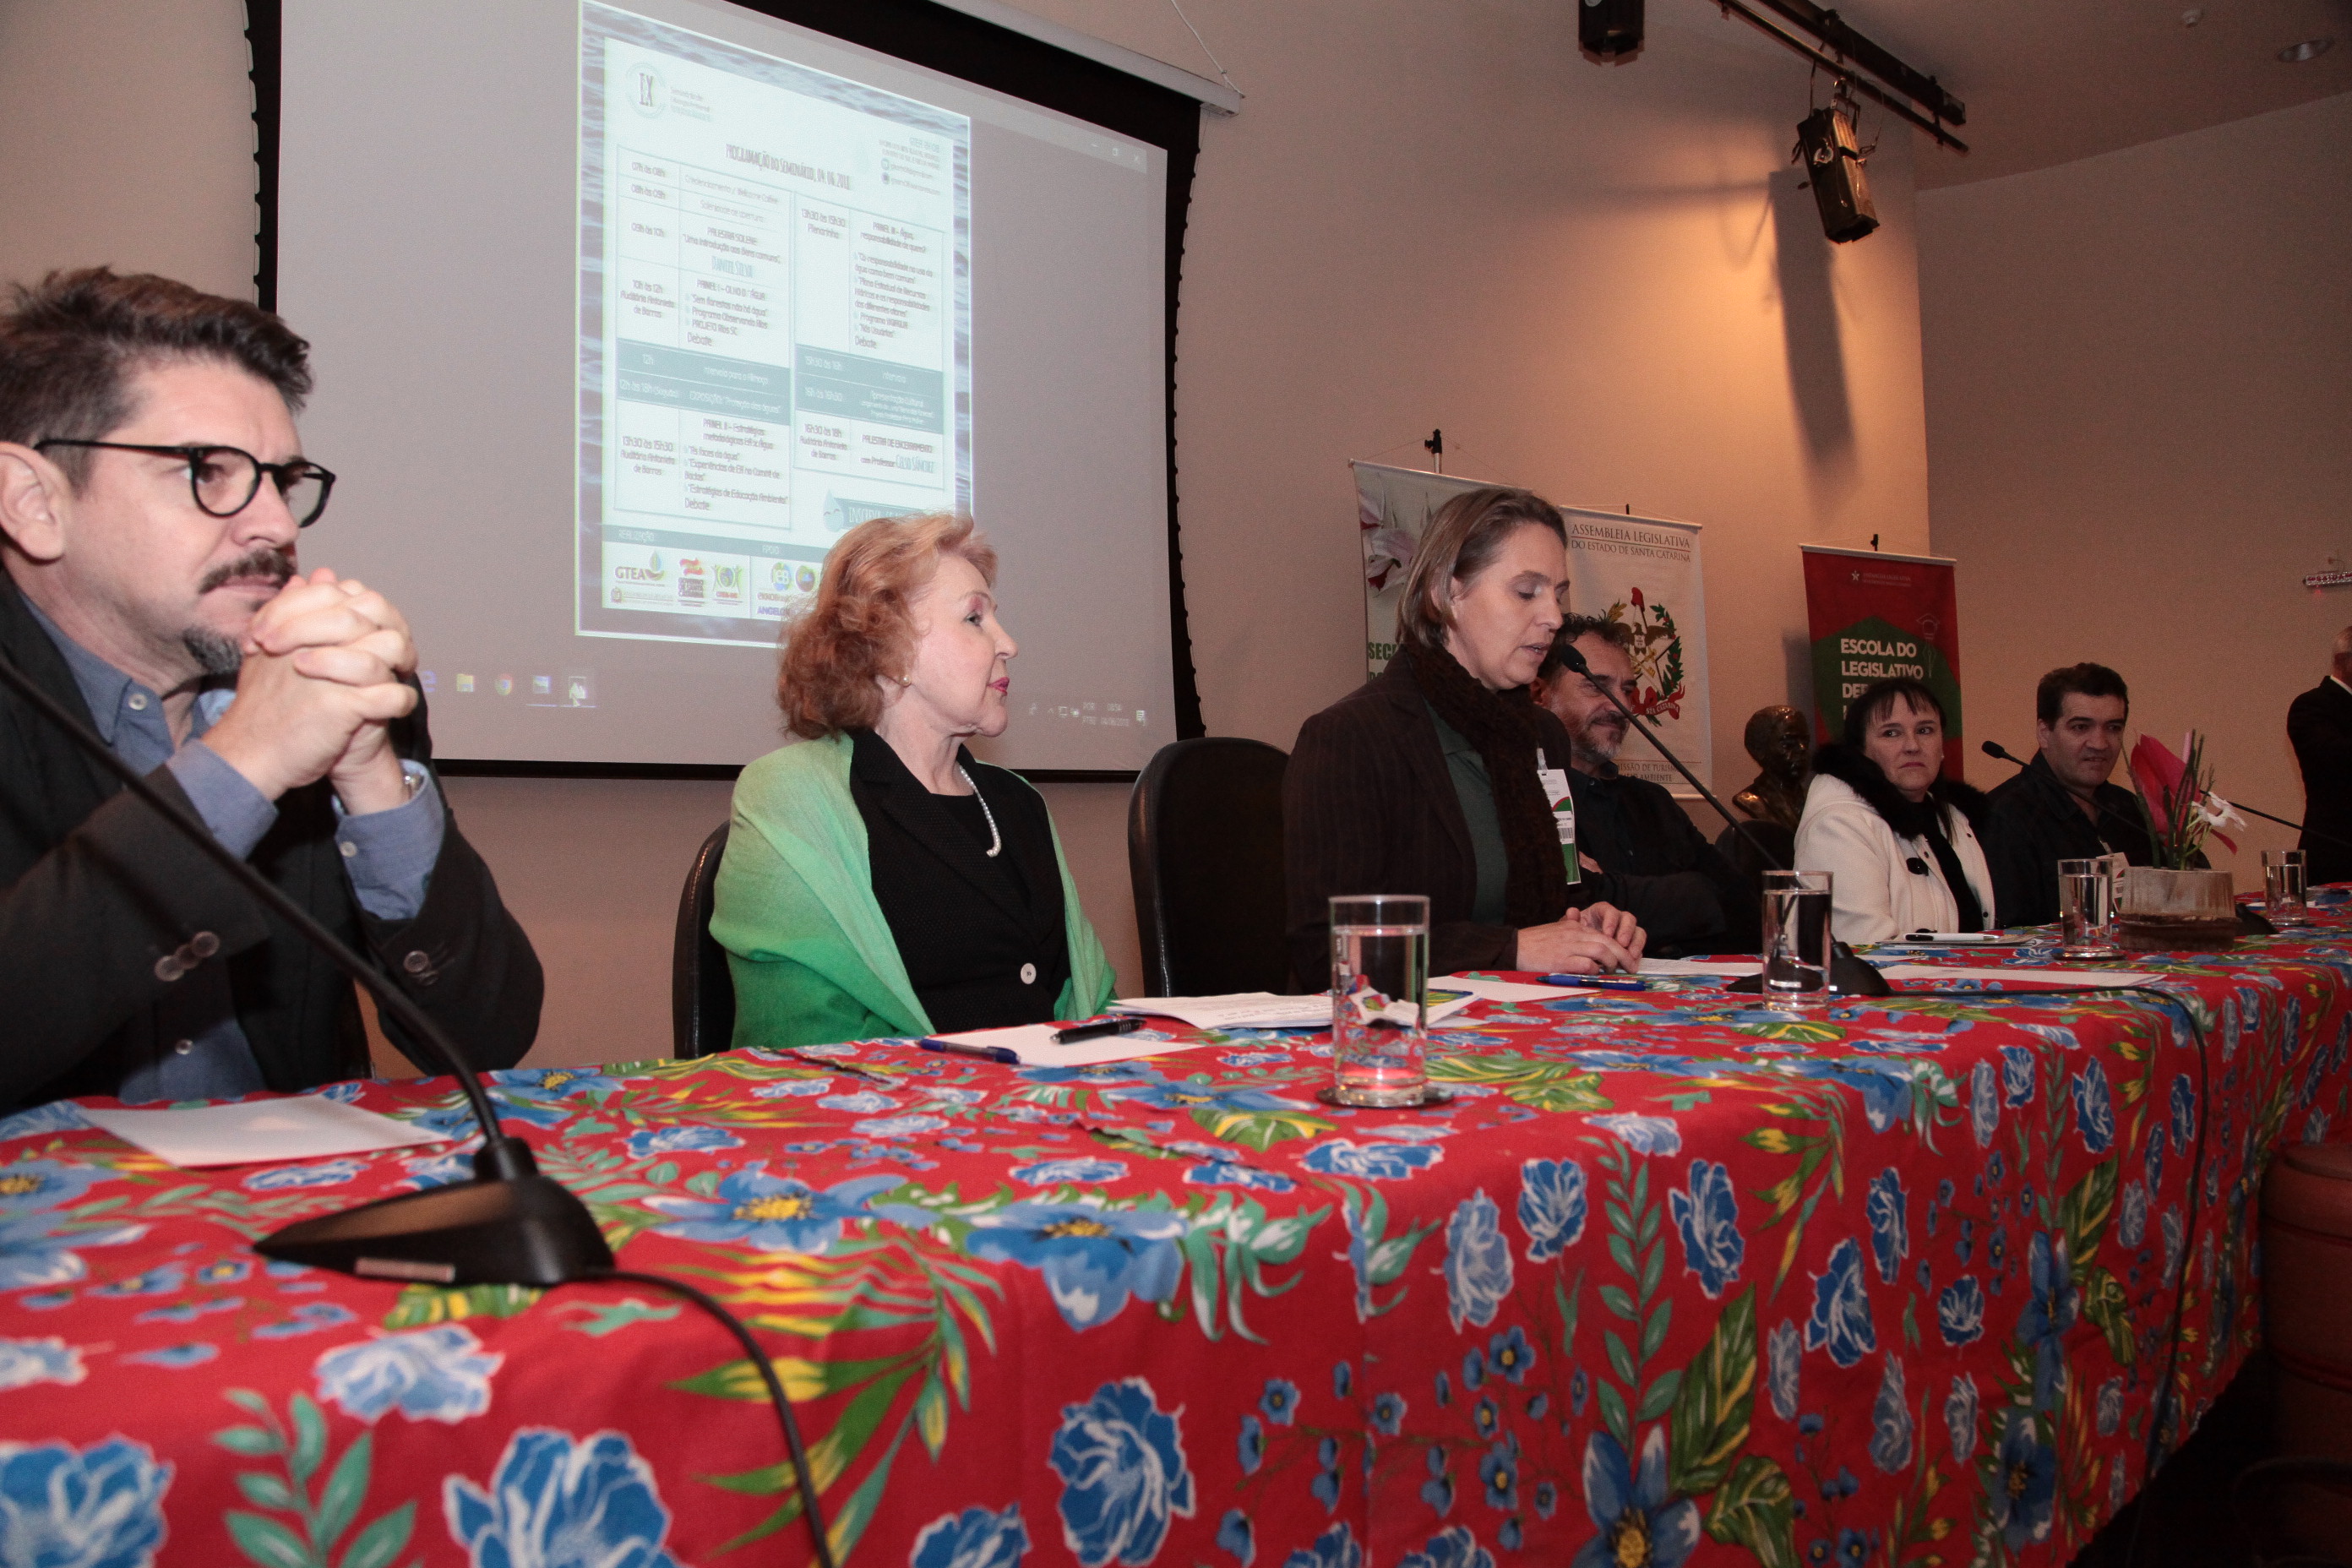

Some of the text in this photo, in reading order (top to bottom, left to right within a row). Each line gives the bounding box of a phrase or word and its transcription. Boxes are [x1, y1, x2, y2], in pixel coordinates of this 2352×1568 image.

[688, 333, 712, 346] Debate
[855, 335, 876, 348] Debate
[685, 498, 709, 509] Debate
[1572, 523, 1690, 548] ASSEMBLEIA LEGISLATIVA
[1571, 540, 1690, 563] DO ESTADO DE SANTA CATARINA
[615, 567, 645, 580] GTEA
[1840, 638, 1917, 658] ESCOLA DO
[1841, 661, 1925, 680] LEGISLATIVO
